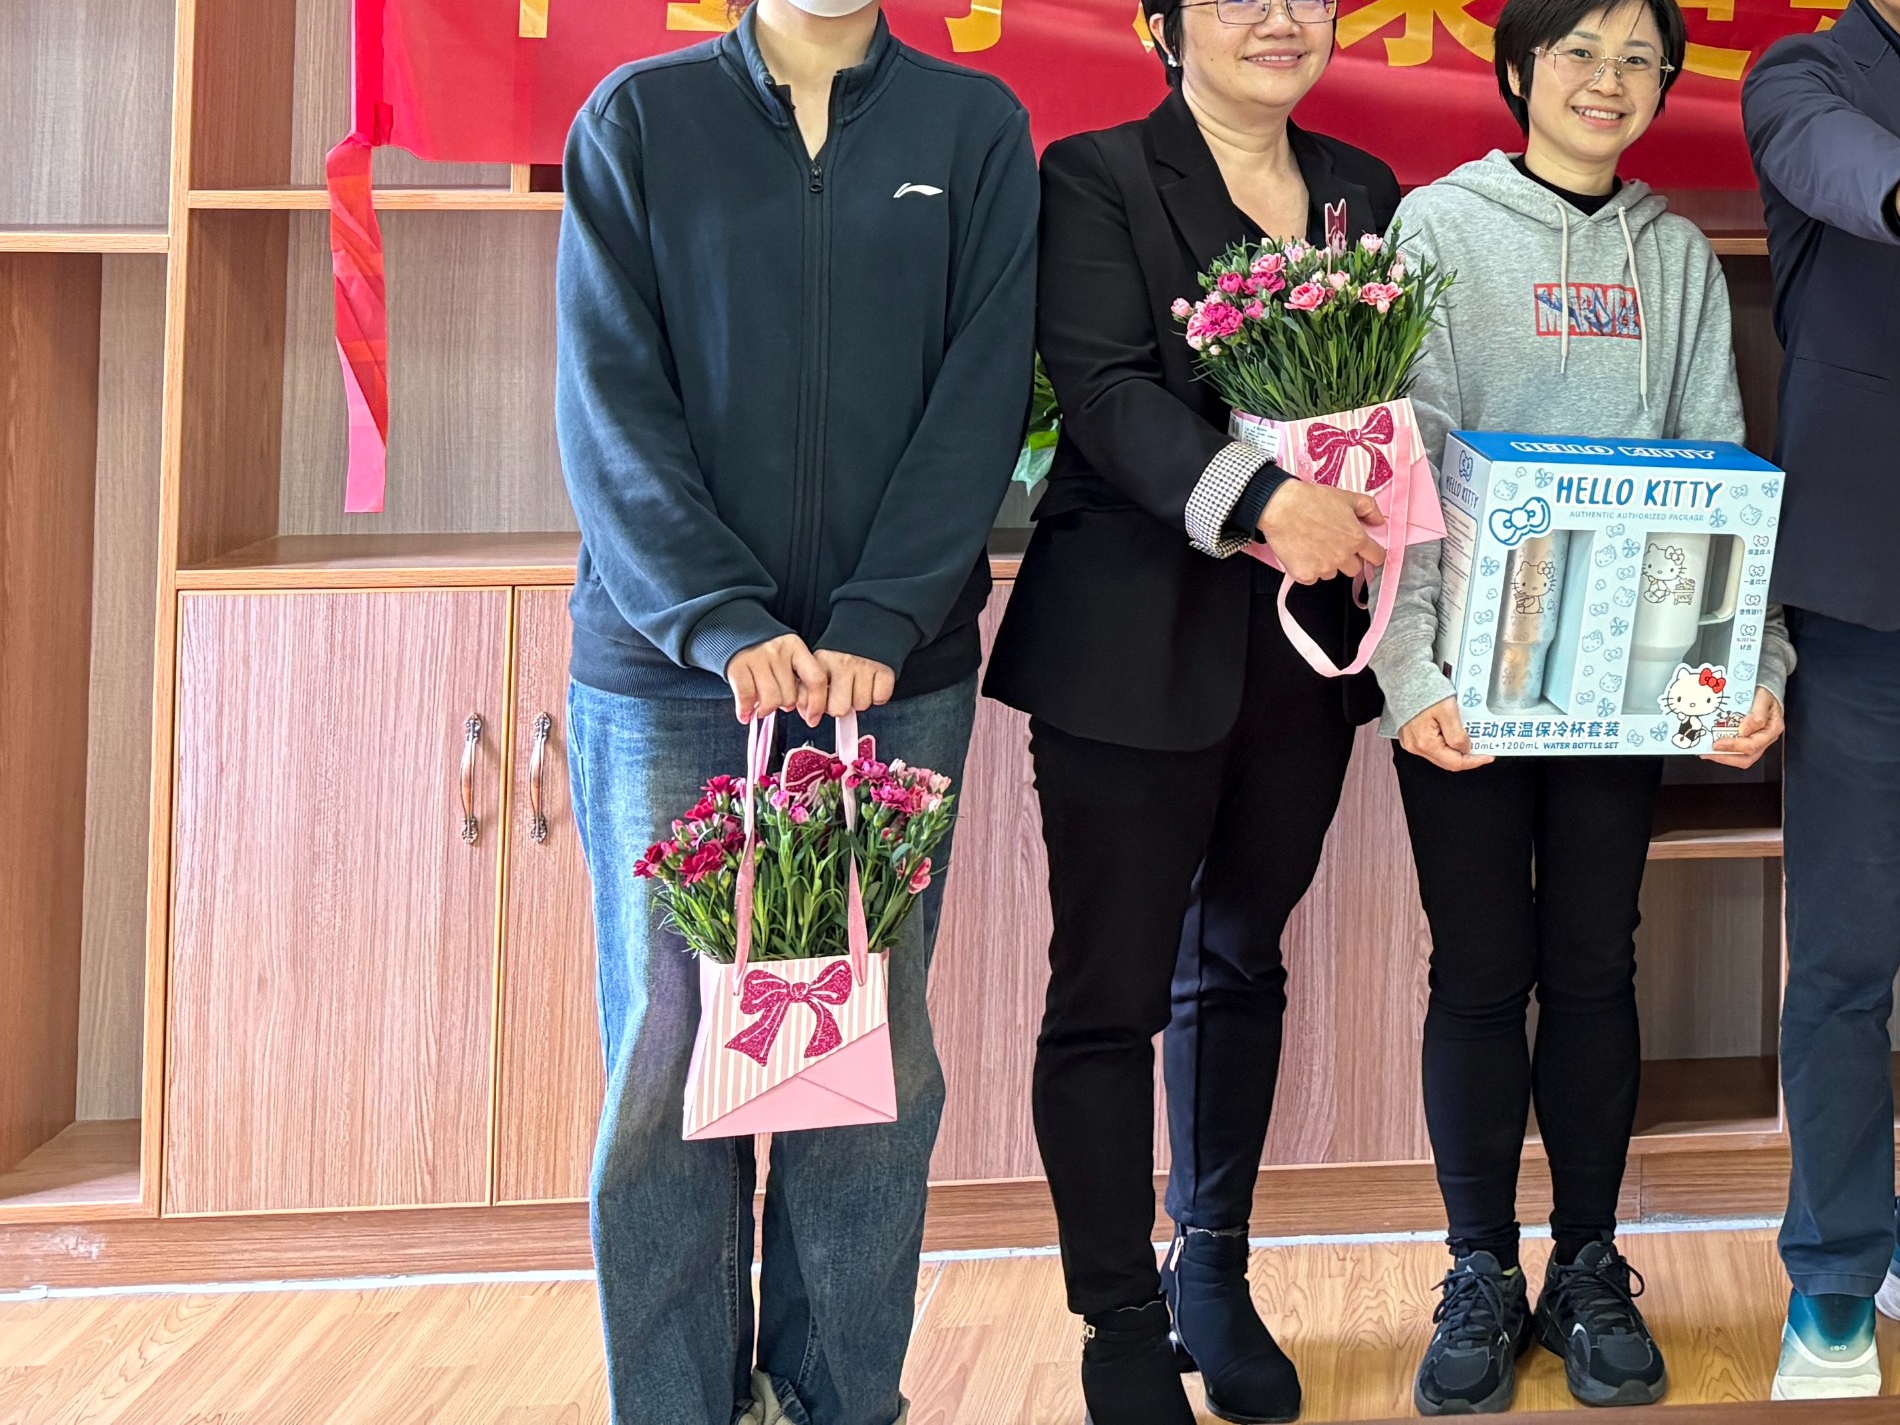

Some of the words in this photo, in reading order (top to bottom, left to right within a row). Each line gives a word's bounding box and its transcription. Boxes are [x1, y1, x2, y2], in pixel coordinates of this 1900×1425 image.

[1556, 476, 1634, 506] HELLO
[1643, 478, 1723, 509] KITTY
[1569, 510, 1615, 519] AUTHENTIC
[1617, 512, 1668, 521] AUTHORIZED
[1669, 513, 1704, 522] PACKAGE
[1465, 720, 1621, 739] 运动保温保冷杯套装
[1543, 741, 1570, 750] WATER
[1572, 741, 1603, 750] BOTTLE
[1604, 741, 1620, 750] SET
